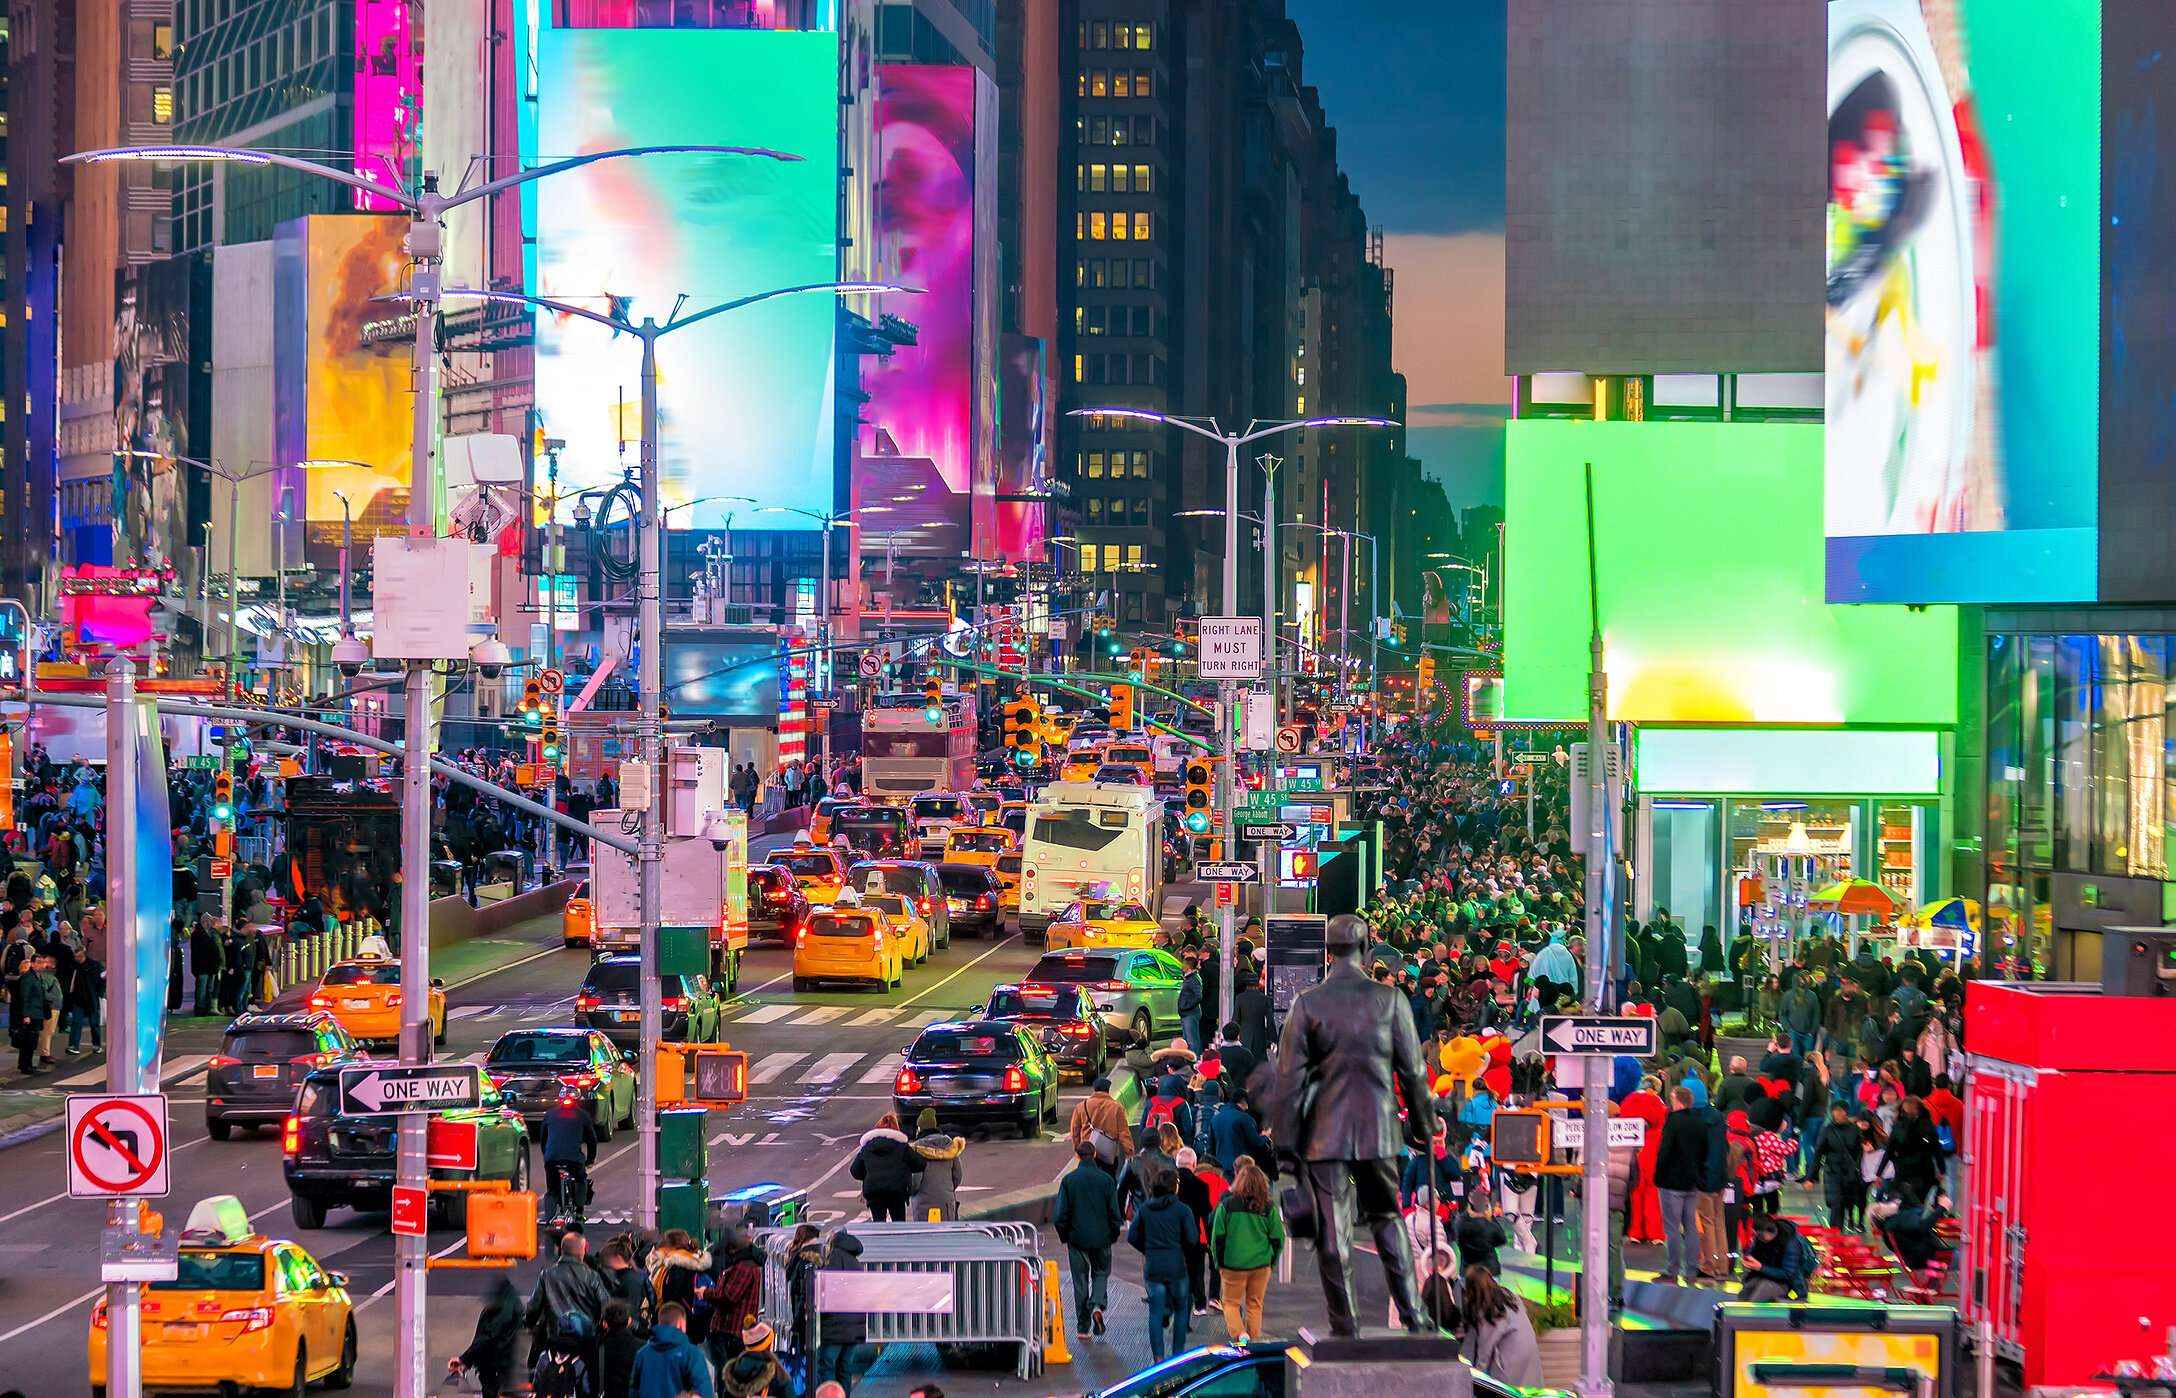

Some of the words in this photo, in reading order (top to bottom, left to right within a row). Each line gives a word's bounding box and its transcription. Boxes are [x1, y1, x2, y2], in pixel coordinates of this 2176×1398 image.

[1202, 625, 1230, 635] RIGHT
[1234, 625, 1259, 635] LANE
[1213, 642, 1247, 654] MUST
[1202, 661, 1226, 671] TURN
[1231, 661, 1258, 671] RIGHT
[200, 757, 211, 768] 45
[1288, 779, 1297, 790] W
[1300, 779, 1311, 789] 45
[1250, 793, 1259, 805] W
[1264, 793, 1276, 806] 45
[1233, 810, 1250, 820] George
[1250, 828, 1266, 836] ONE
[1273, 828, 1288, 836] WAY
[1205, 867, 1223, 876] ONE
[1231, 867, 1249, 876] WAY
[1575, 1029, 1606, 1043] ONE
[1611, 1030, 1642, 1043] WAY
[383, 1081, 420, 1099] ONE
[427, 1079, 464, 1097] WAY
